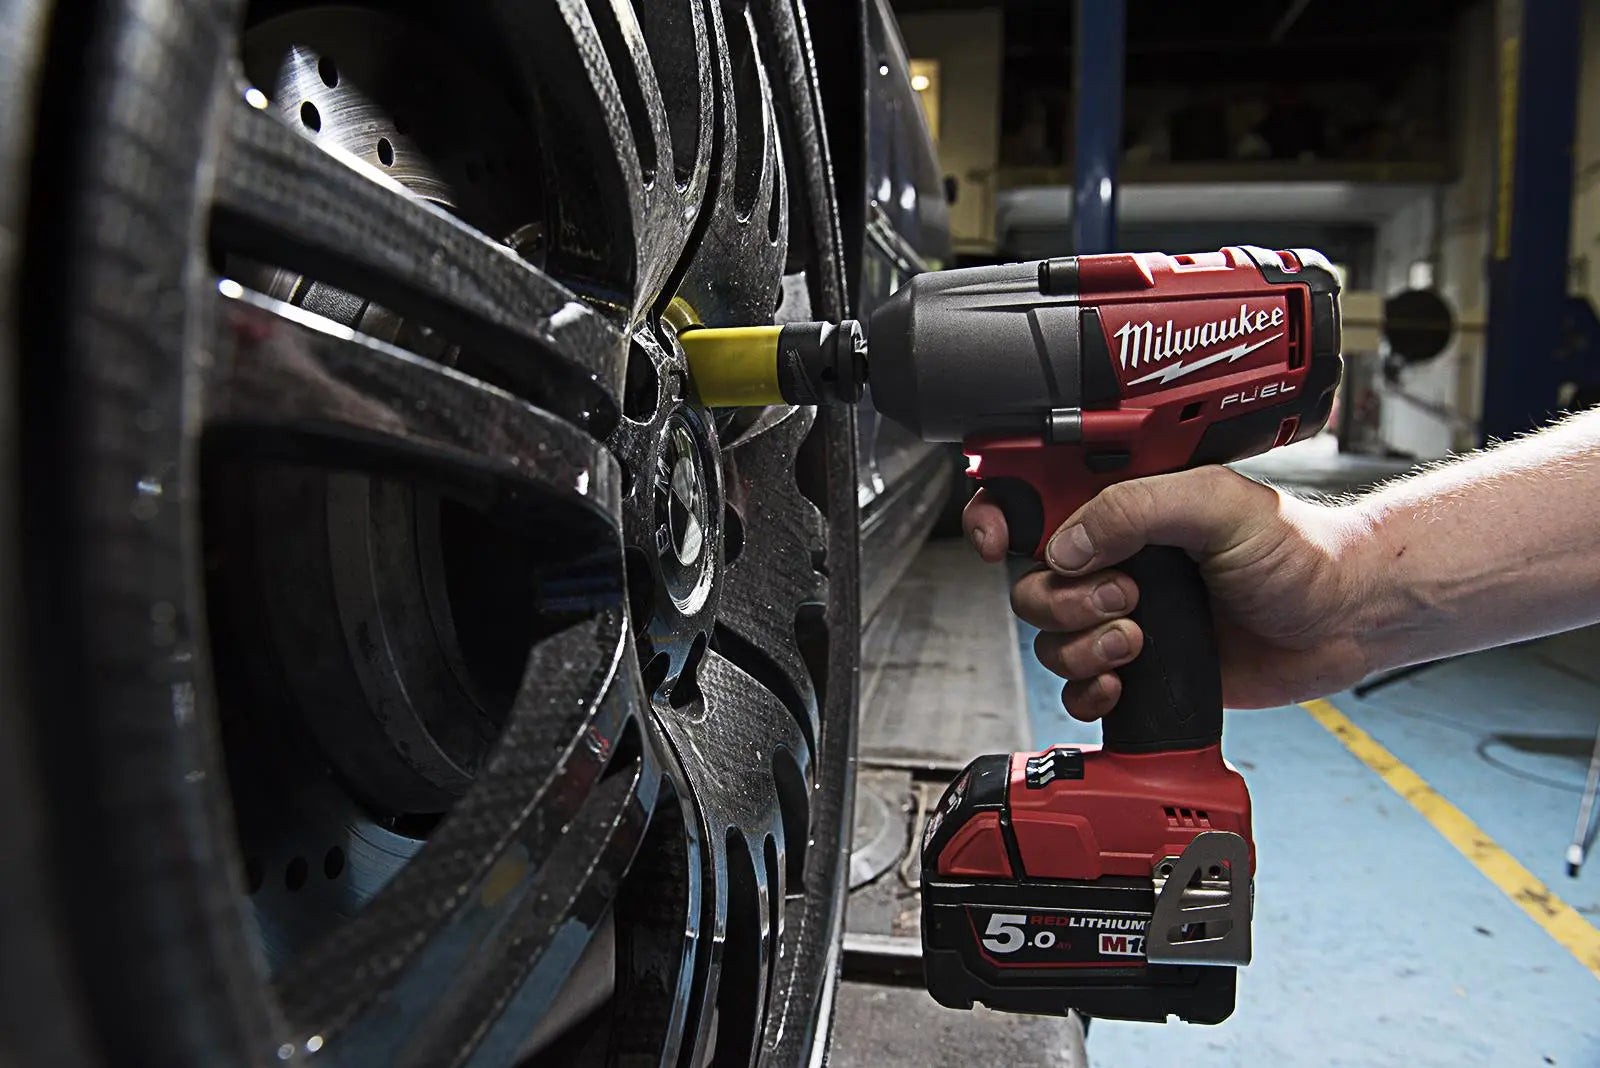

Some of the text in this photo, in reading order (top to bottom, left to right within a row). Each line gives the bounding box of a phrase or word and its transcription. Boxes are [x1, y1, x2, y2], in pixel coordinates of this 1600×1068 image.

[1113, 303, 1285, 371] Milwaukee
[1220, 381, 1296, 410] FUEL
[982, 912, 1056, 953] 5.0
